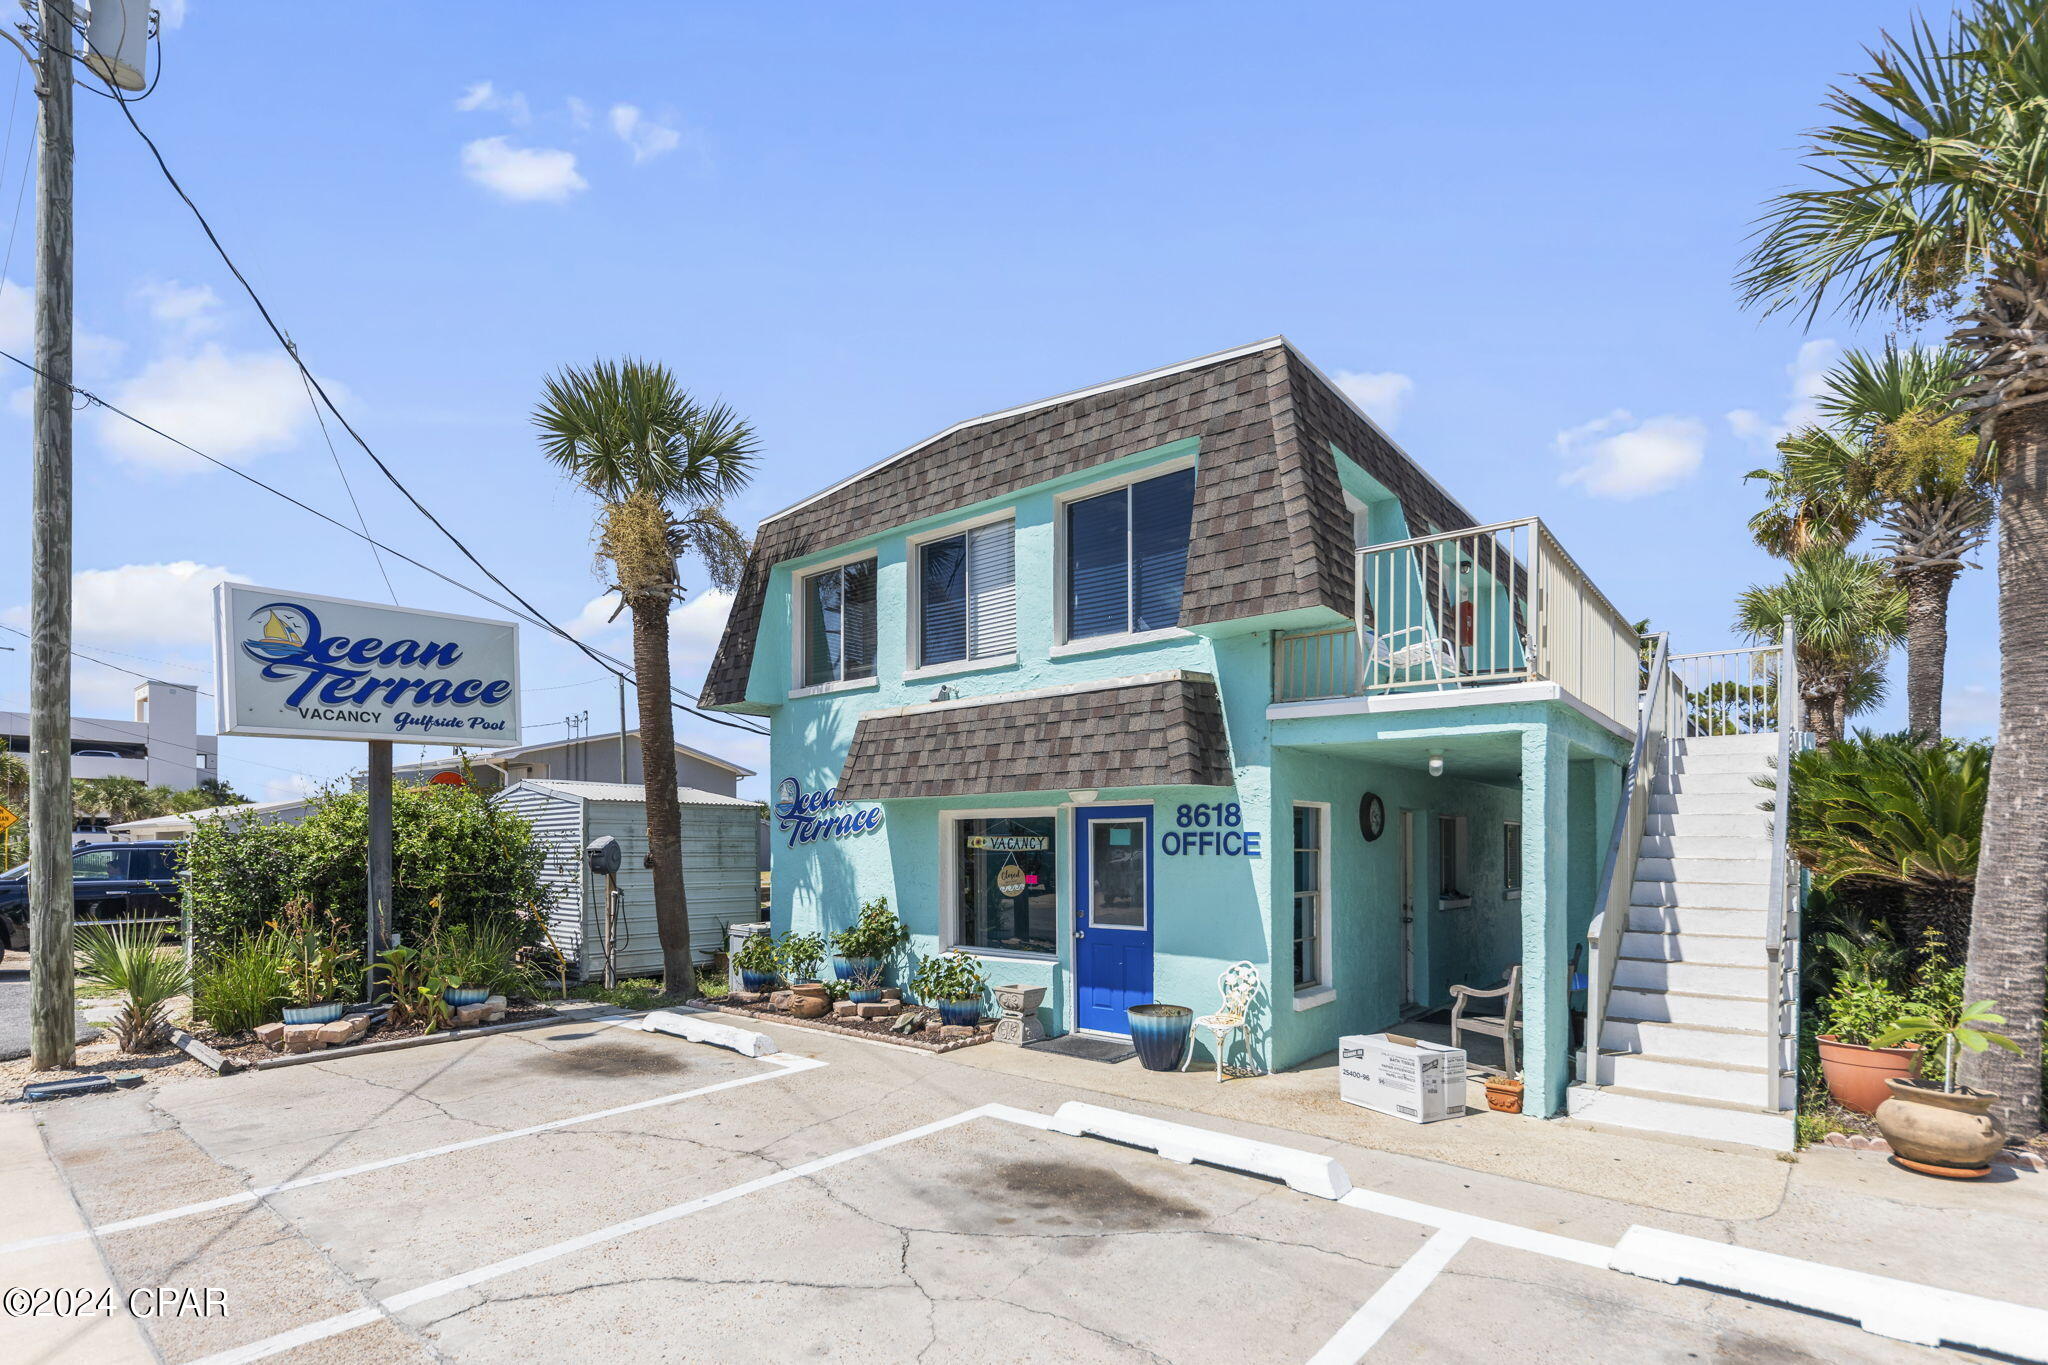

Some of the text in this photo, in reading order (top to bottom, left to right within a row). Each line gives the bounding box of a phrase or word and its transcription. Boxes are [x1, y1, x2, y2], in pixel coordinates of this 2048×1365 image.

[243, 602, 464, 668] Ocean
[261, 657, 513, 708] Terrace
[298, 707, 382, 724] VACANCY
[393, 711, 506, 732] Gulfside Pool
[1176, 802, 1242, 828] 8618
[780, 806, 882, 849] Terrace
[990, 837, 1045, 850] VACANCY
[1161, 831, 1261, 857] OFFICE
[1001, 869, 1021, 881] Closed
[1342, 1068, 1371, 1082] 25400-96
